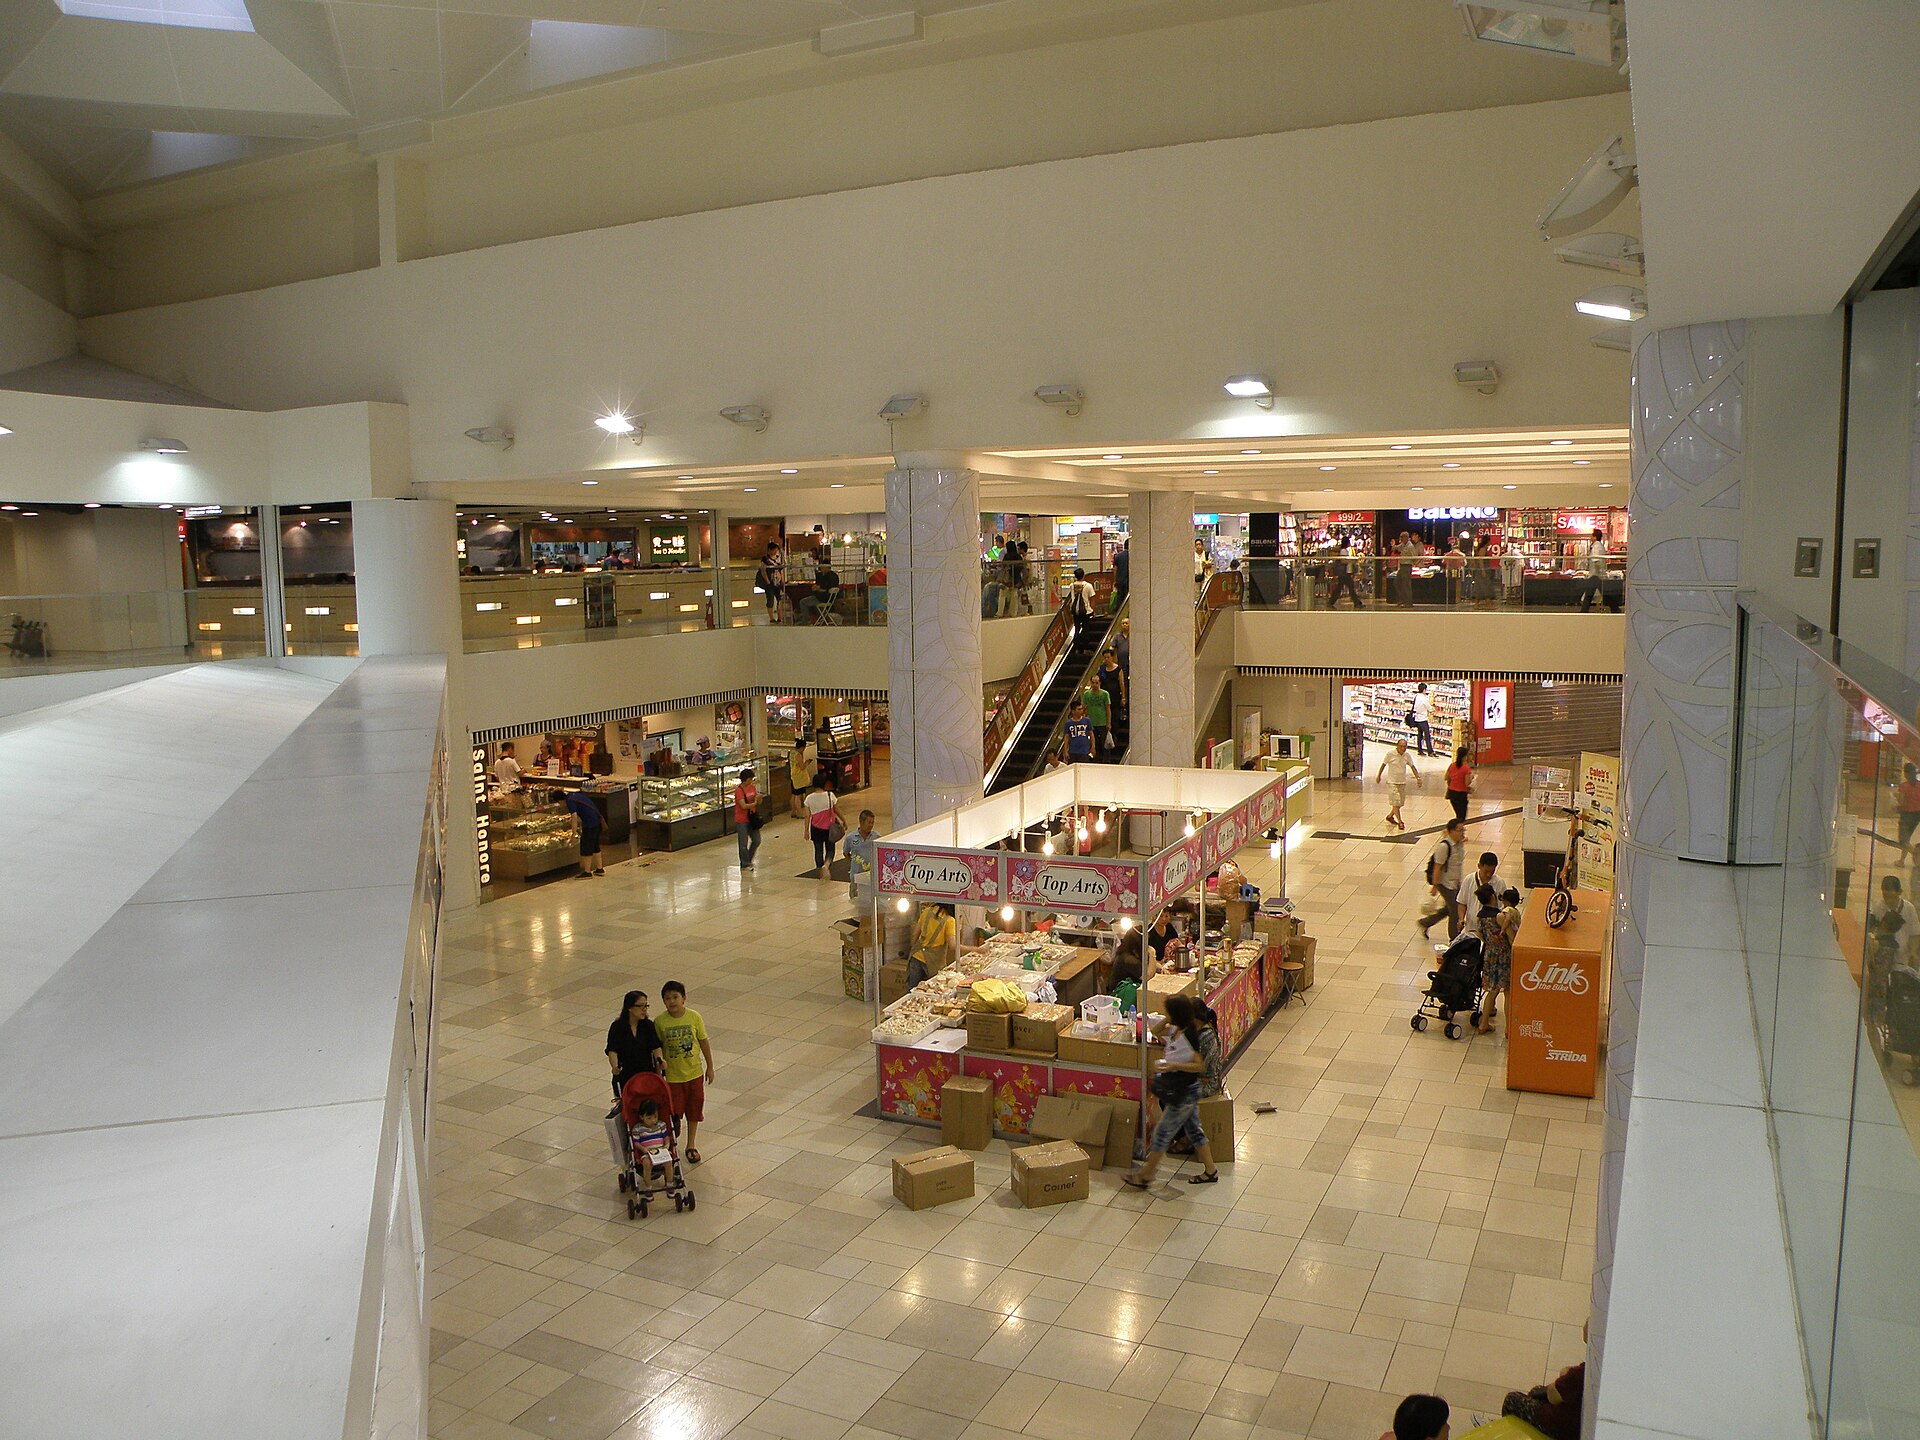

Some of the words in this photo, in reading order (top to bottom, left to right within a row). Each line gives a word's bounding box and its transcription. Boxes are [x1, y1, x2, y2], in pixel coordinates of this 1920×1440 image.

[1557, 516, 1596, 529] SALE
[1478, 528, 1501, 536] SALE
[1069, 724, 1088, 734] CITY
[1070, 730, 1087, 738] LIFE
[473, 748, 488, 803] Saint
[1589, 767, 1610, 779] Caleb's
[476, 814, 491, 884] Honore
[909, 864, 935, 884] Top
[936, 867, 968, 883] Arts
[1165, 866, 1175, 883] Top
[1175, 859, 1187, 877] Arts
[1042, 875, 1068, 895] Top
[1071, 878, 1104, 895] Arts
[1524, 960, 1586, 989] Link
[1552, 983, 1570, 992] Bike
[1043, 1180, 1076, 1193] Corner
